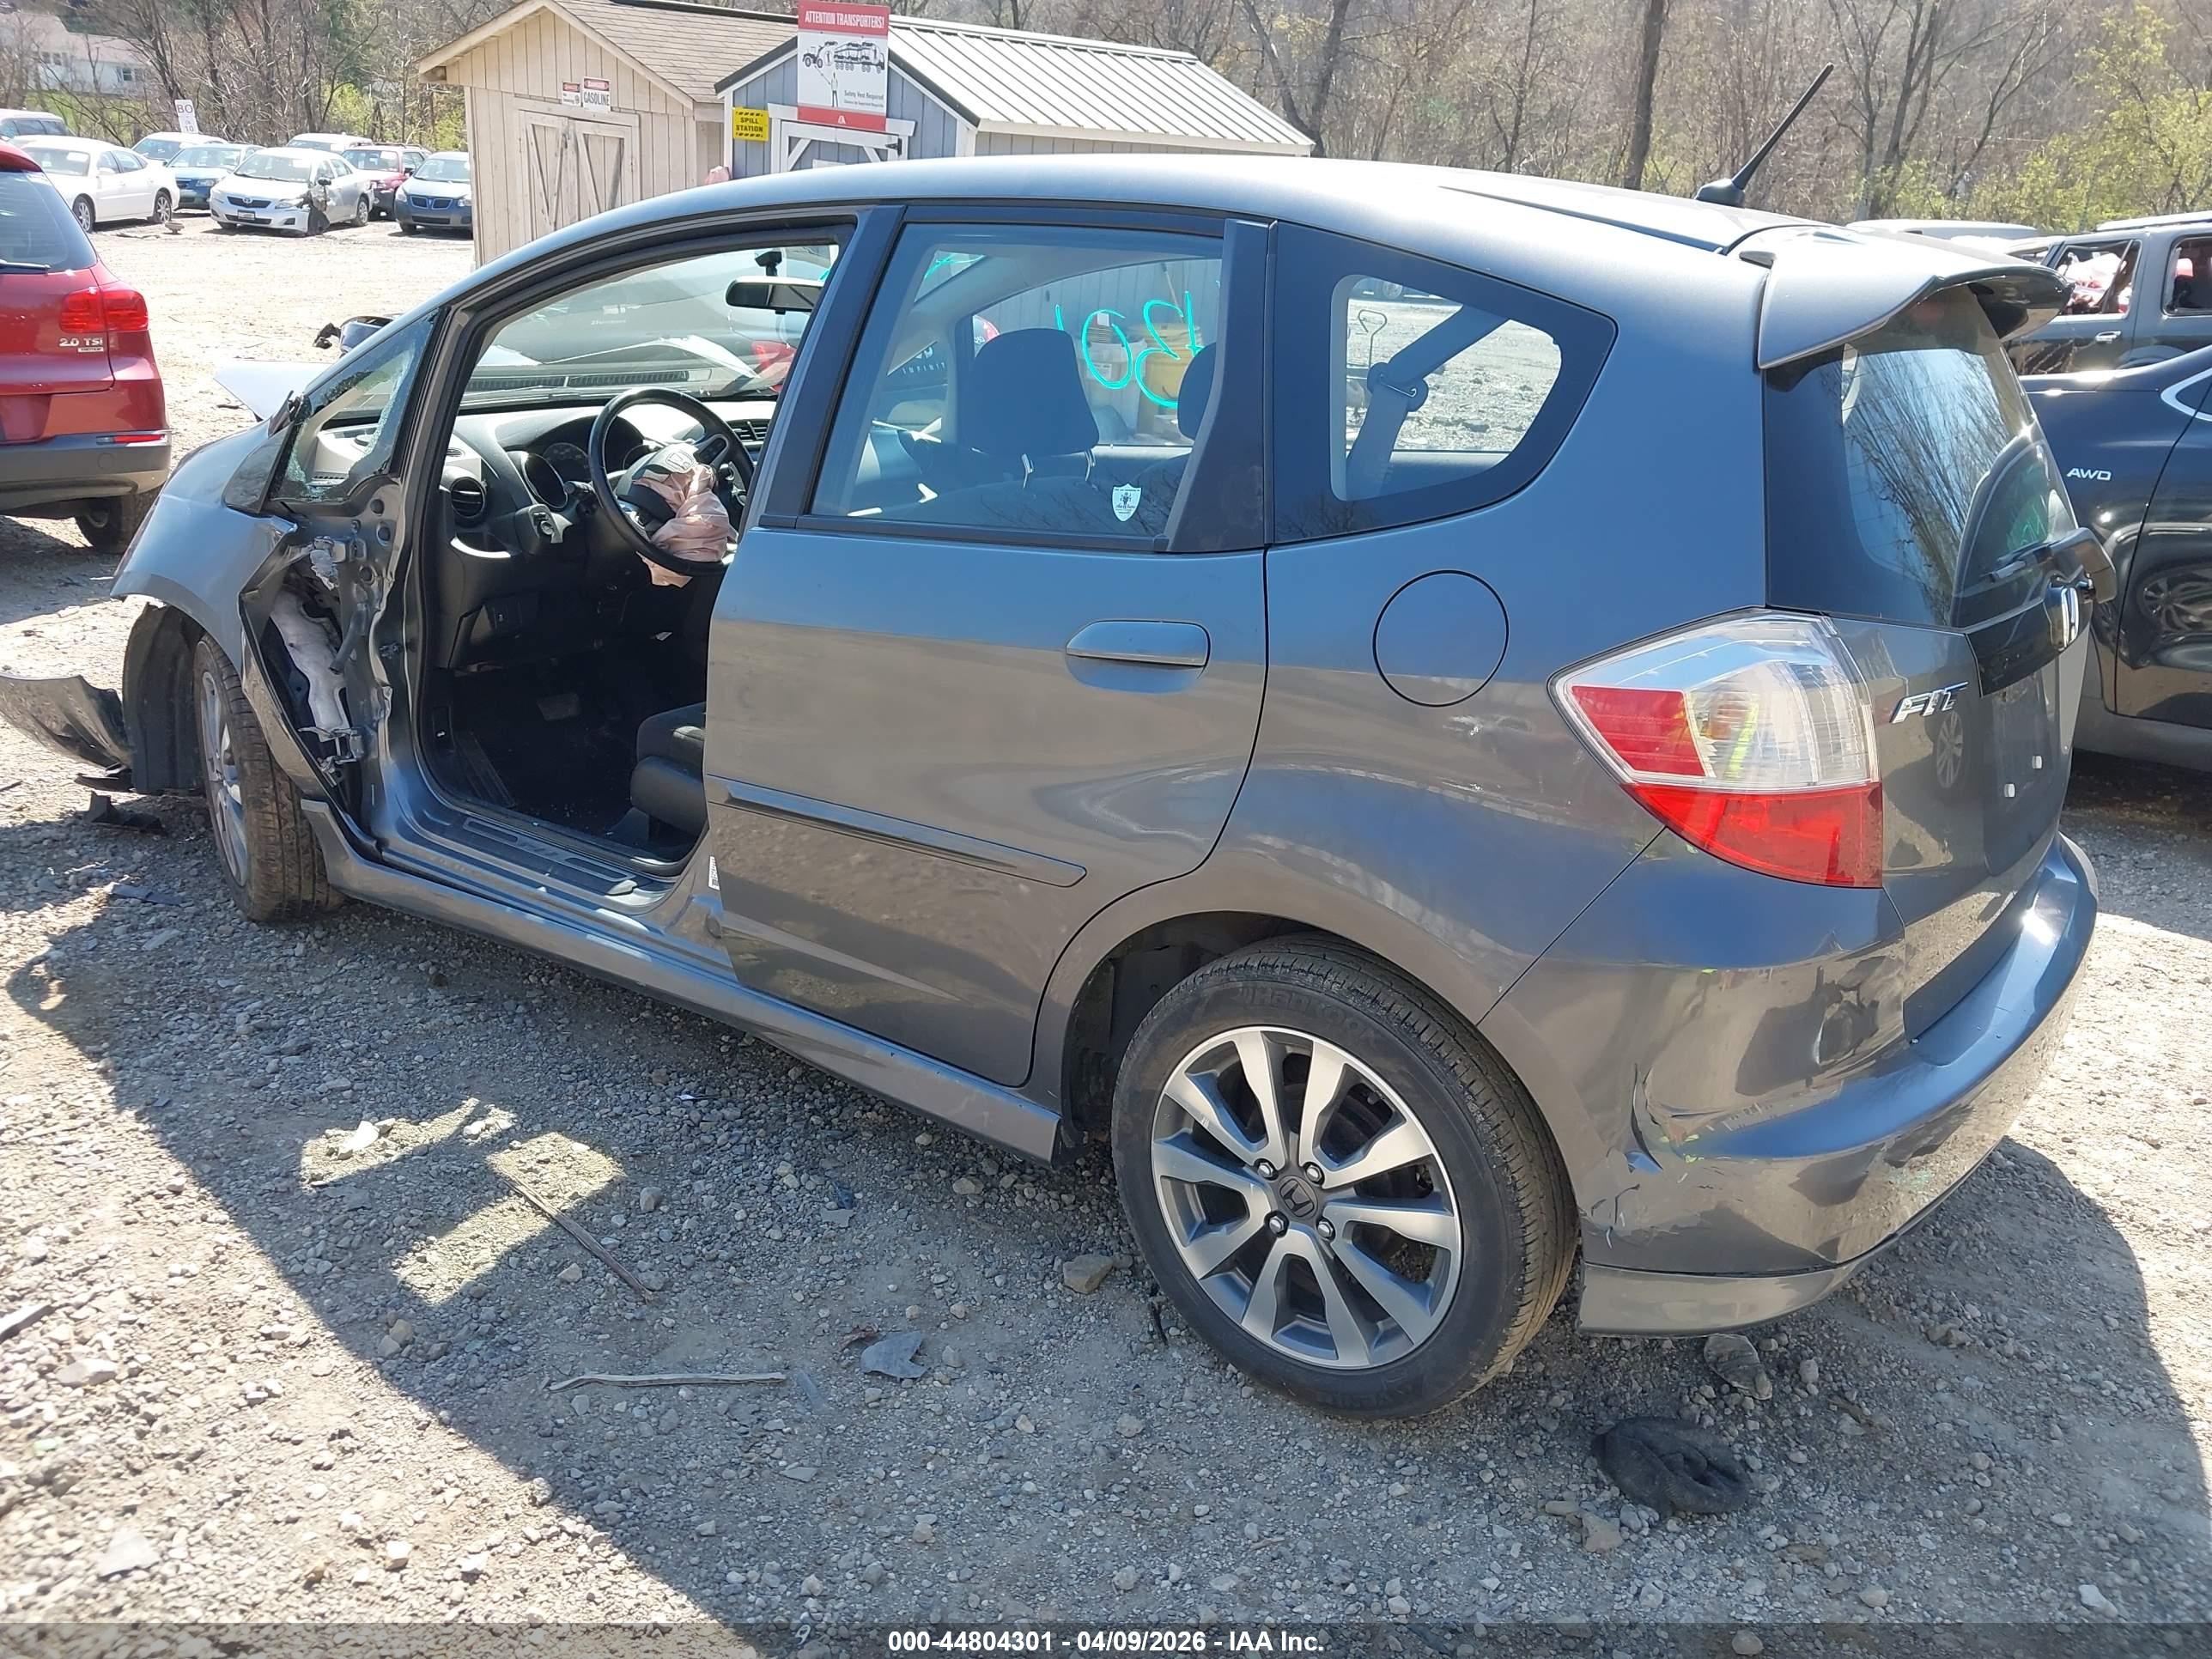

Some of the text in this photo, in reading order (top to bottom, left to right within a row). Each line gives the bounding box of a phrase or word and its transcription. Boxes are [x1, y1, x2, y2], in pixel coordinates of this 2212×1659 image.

[805, 10, 884, 29] ATTENTION TRANSPORTERS!
[584, 91, 610, 106] GASOLINE
[83, 337, 103, 346] TSI
[2066, 467, 2112, 481] AWD
[1889, 681, 1969, 724] FIT
